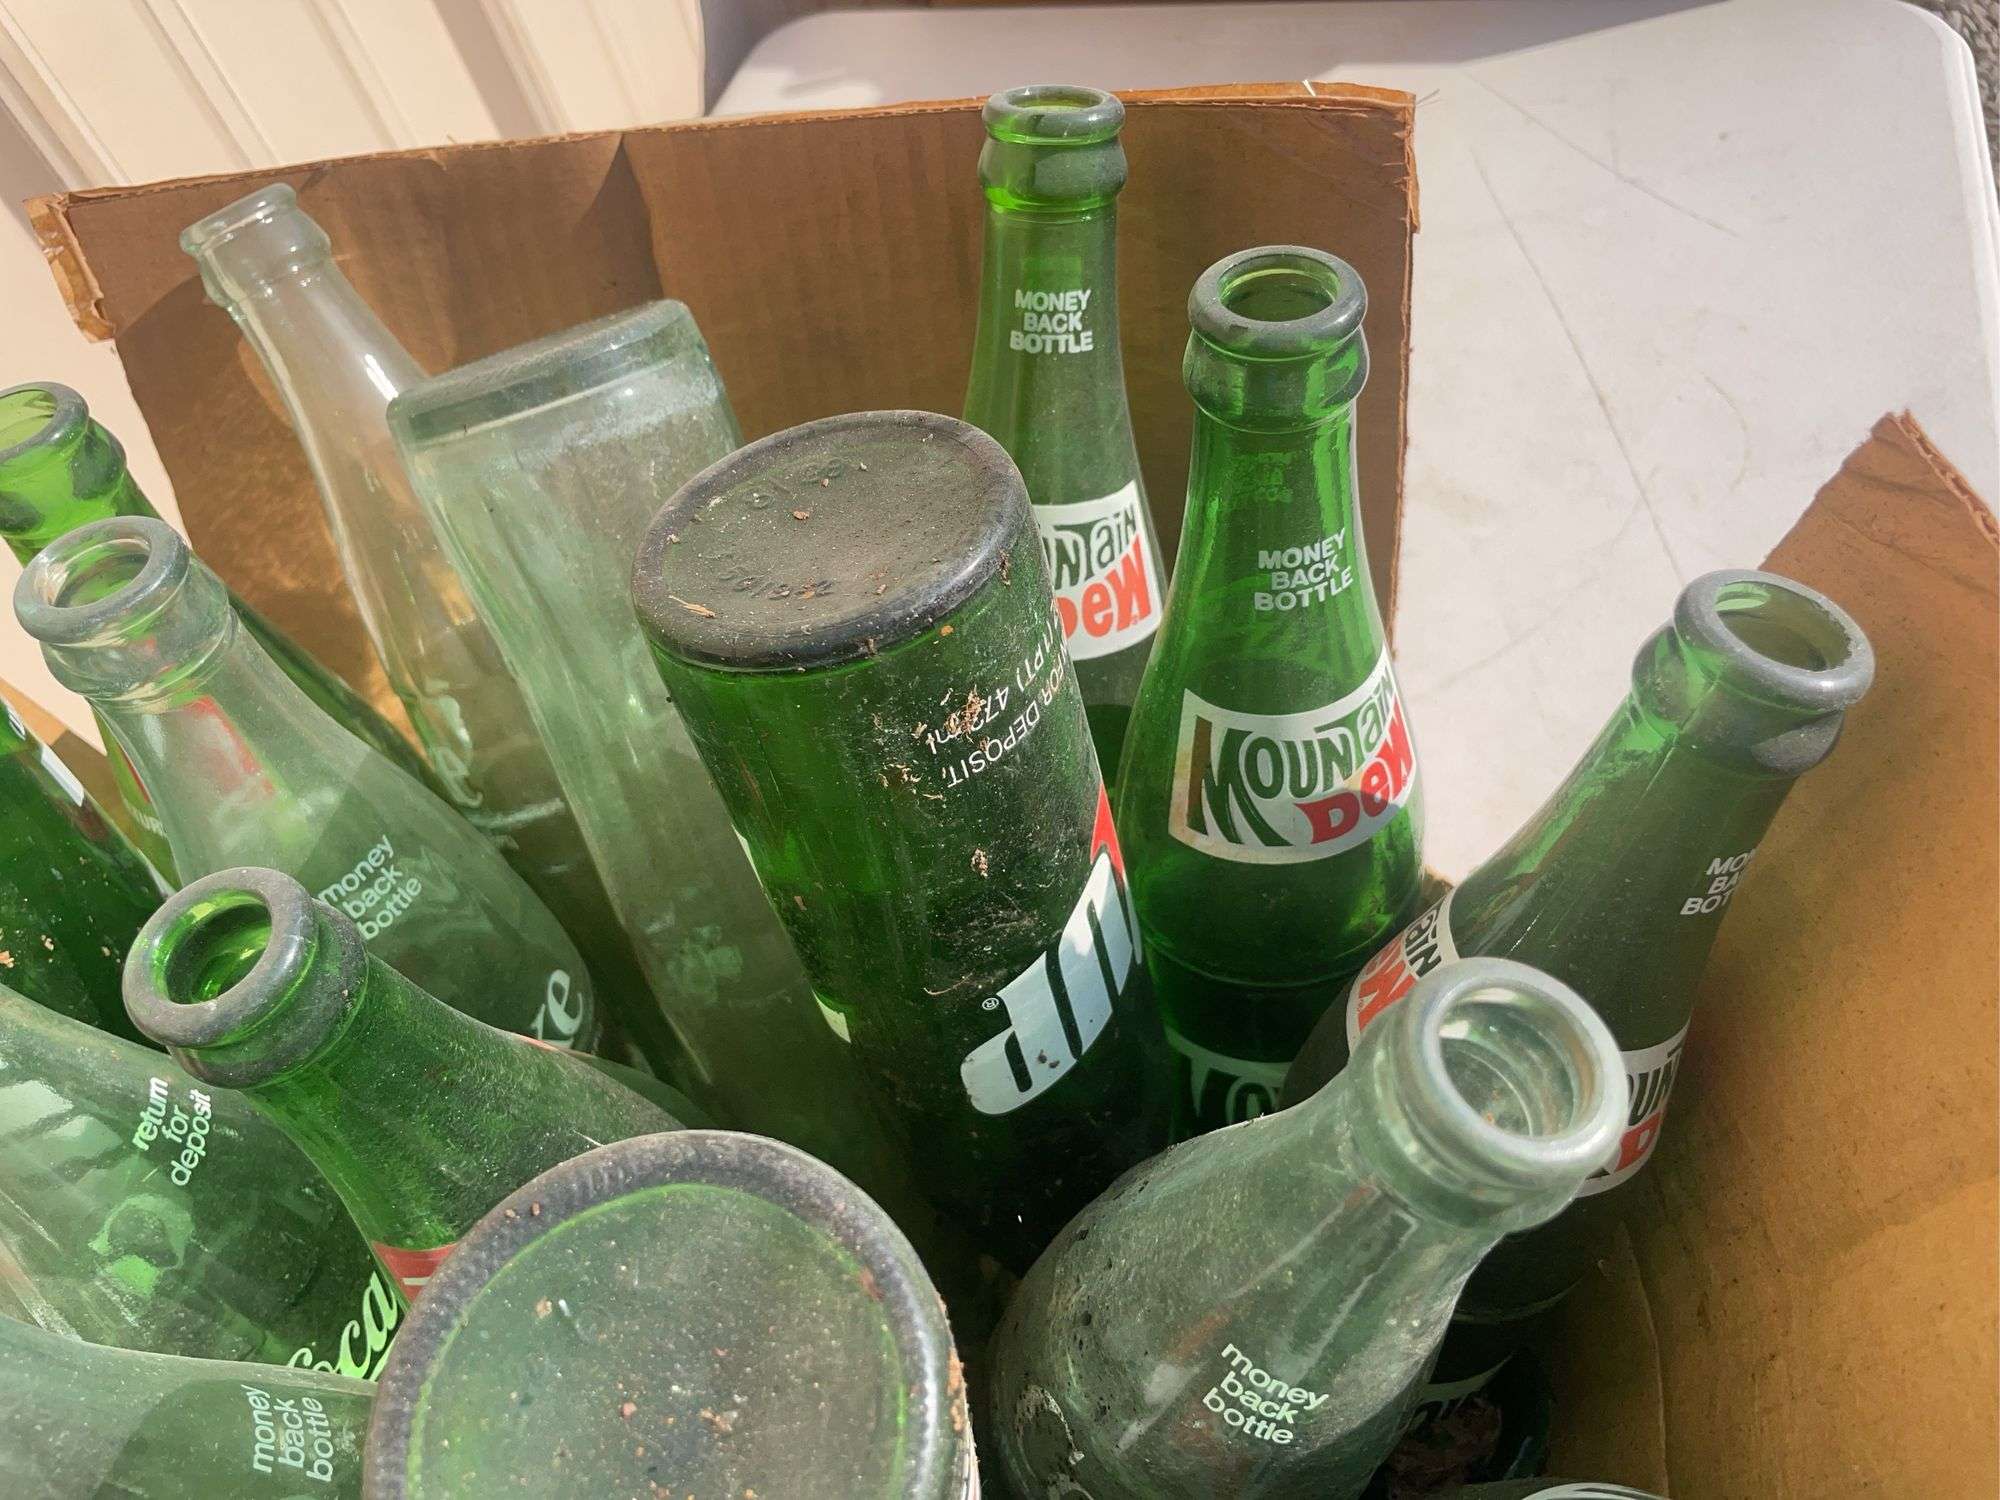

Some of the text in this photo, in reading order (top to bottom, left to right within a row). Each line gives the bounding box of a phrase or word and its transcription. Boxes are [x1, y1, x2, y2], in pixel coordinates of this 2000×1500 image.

[1014, 289, 1091, 312] MONEY
[1023, 311, 1083, 334] BACK
[1009, 331, 1094, 354] BOTTLE
[1258, 527, 1346, 569] MONEY
[1271, 554, 1340, 590] BACK
[1254, 565, 1354, 611] BOTTLE
[1041, 653, 1064, 706] FOR
[318, 834, 394, 908] money
[342, 864, 403, 919] back
[356, 877, 422, 940] bottle
[132, 1077, 169, 1151] return
[161, 1104, 190, 1143] for
[170, 1088, 212, 1186] deposit
[1220, 1370, 1299, 1424] back
[1221, 1343, 1330, 1410] money
[241, 1384, 276, 1474] money
[273, 1398, 305, 1469] back
[301, 1397, 334, 1482] bottle
[1202, 1387, 1294, 1444] bottle
